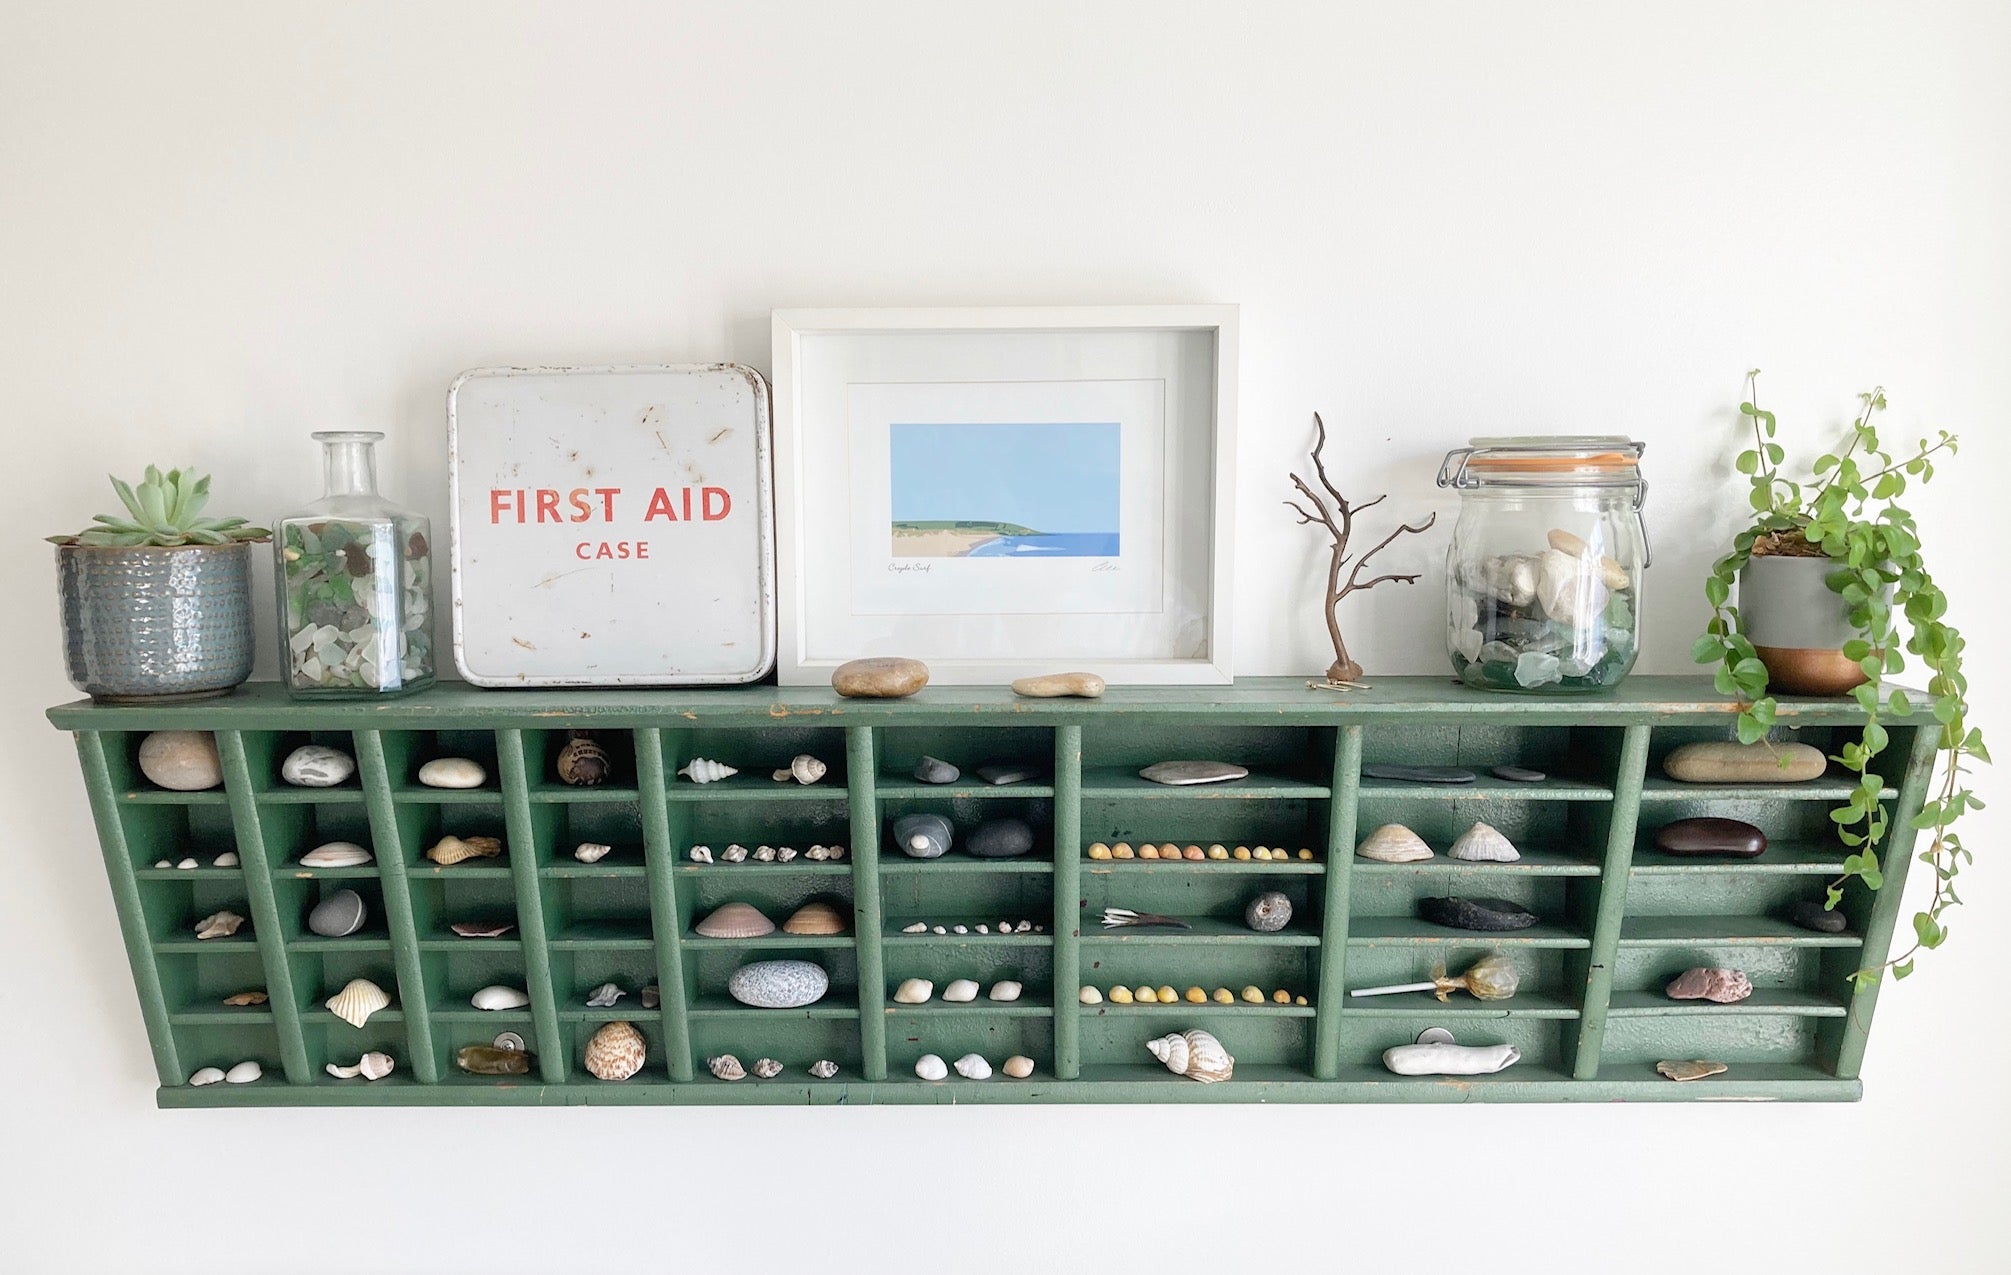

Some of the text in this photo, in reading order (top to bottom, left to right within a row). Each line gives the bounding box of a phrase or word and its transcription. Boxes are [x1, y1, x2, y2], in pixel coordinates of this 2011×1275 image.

[490, 487, 732, 524] FIRST AID
[575, 541, 649, 560] CASE
